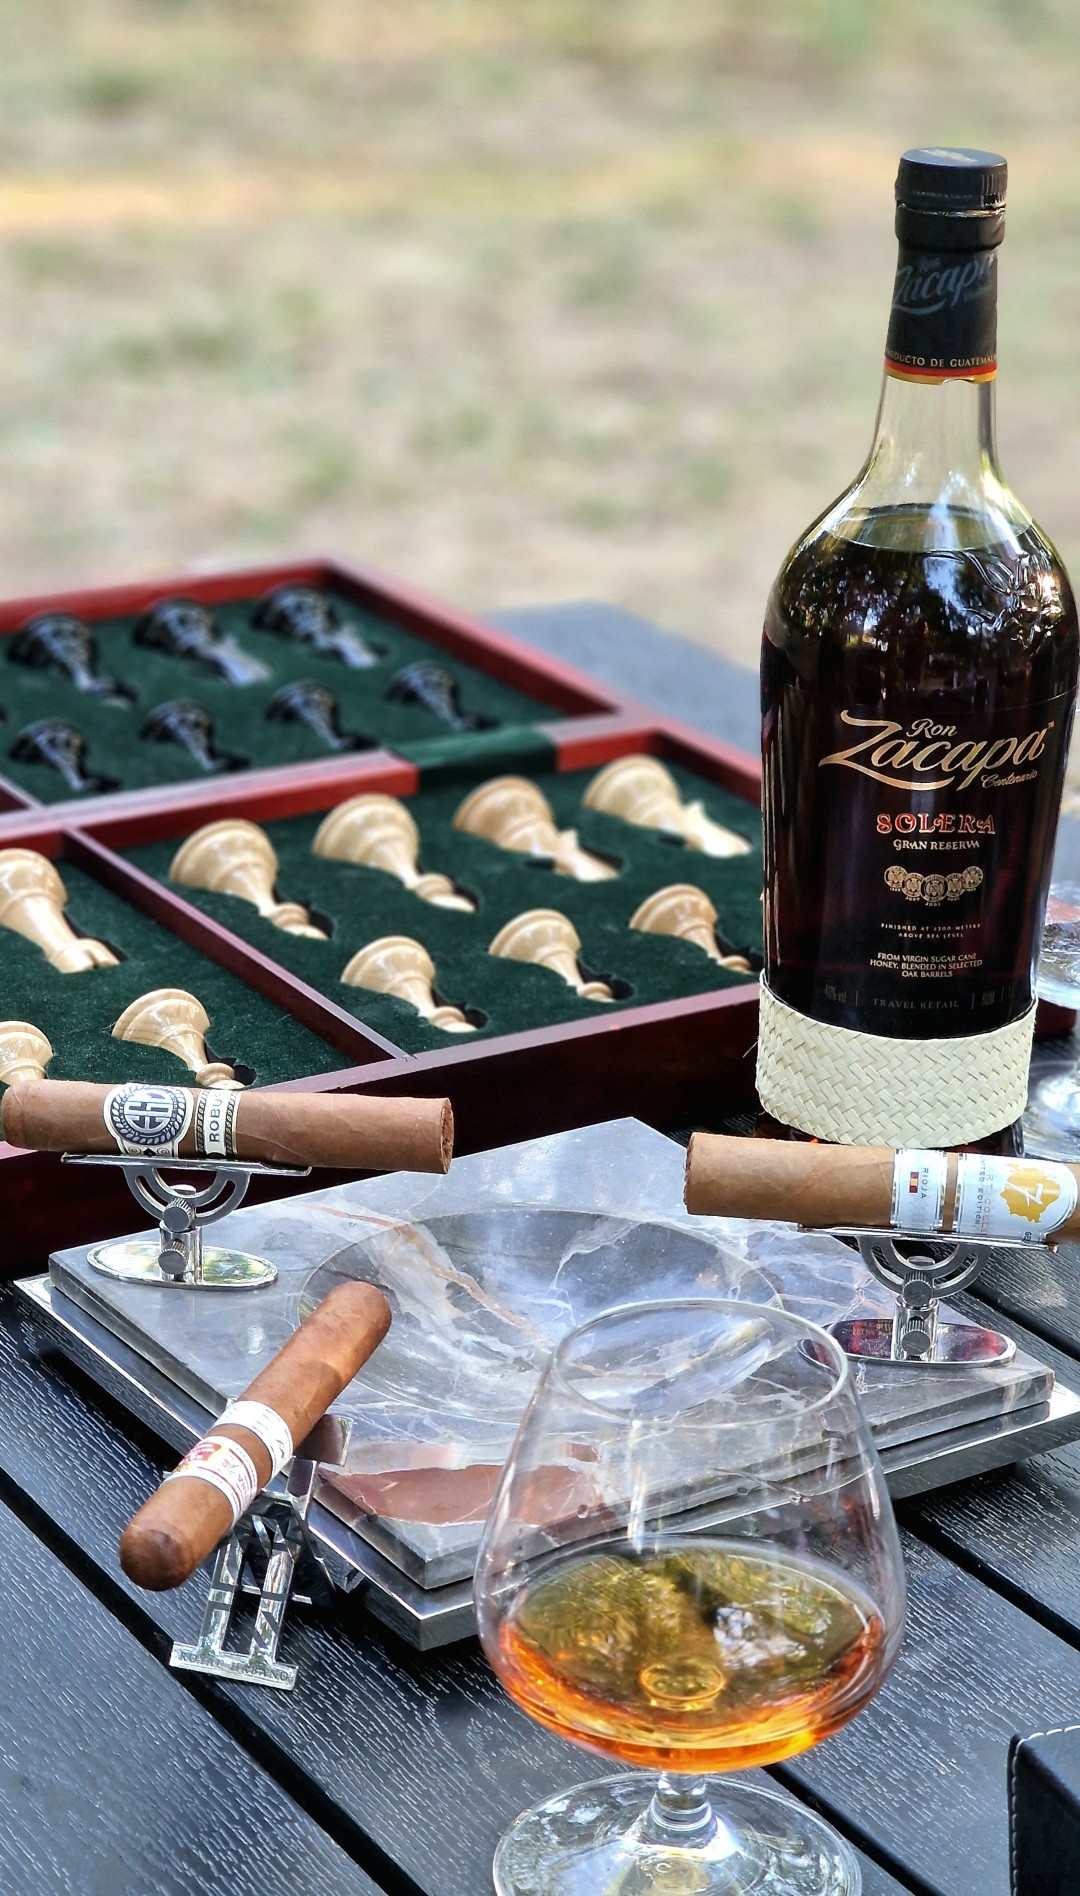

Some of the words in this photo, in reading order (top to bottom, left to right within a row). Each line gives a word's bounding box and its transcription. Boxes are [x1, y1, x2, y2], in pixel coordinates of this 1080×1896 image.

[930, 358, 945, 368] DE
[906, 718, 957, 739] Ron
[818, 709, 1048, 792] Zacapa
[980, 769, 1038, 789] Centenario
[876, 812, 996, 835] SOLERA
[893, 839, 927, 851] GRAN
[929, 839, 980, 851] RESERVA
[877, 951, 900, 961] FROM
[902, 954, 929, 963] VIRGIN
[930, 954, 956, 963] SUGAR
[957, 952, 977, 961] CANE
[869, 958, 899, 970] HONEY,
[901, 962, 936, 970] BLENDED
[948, 959, 982, 970] SELECTED
[901, 970, 918, 978] OAK
[920, 970, 953, 978] BARRELS
[874, 998, 915, 1009] TRAVEL
[920, 1000, 959, 1010] RETAIL
[920, 1167, 929, 1199] RIOJA
